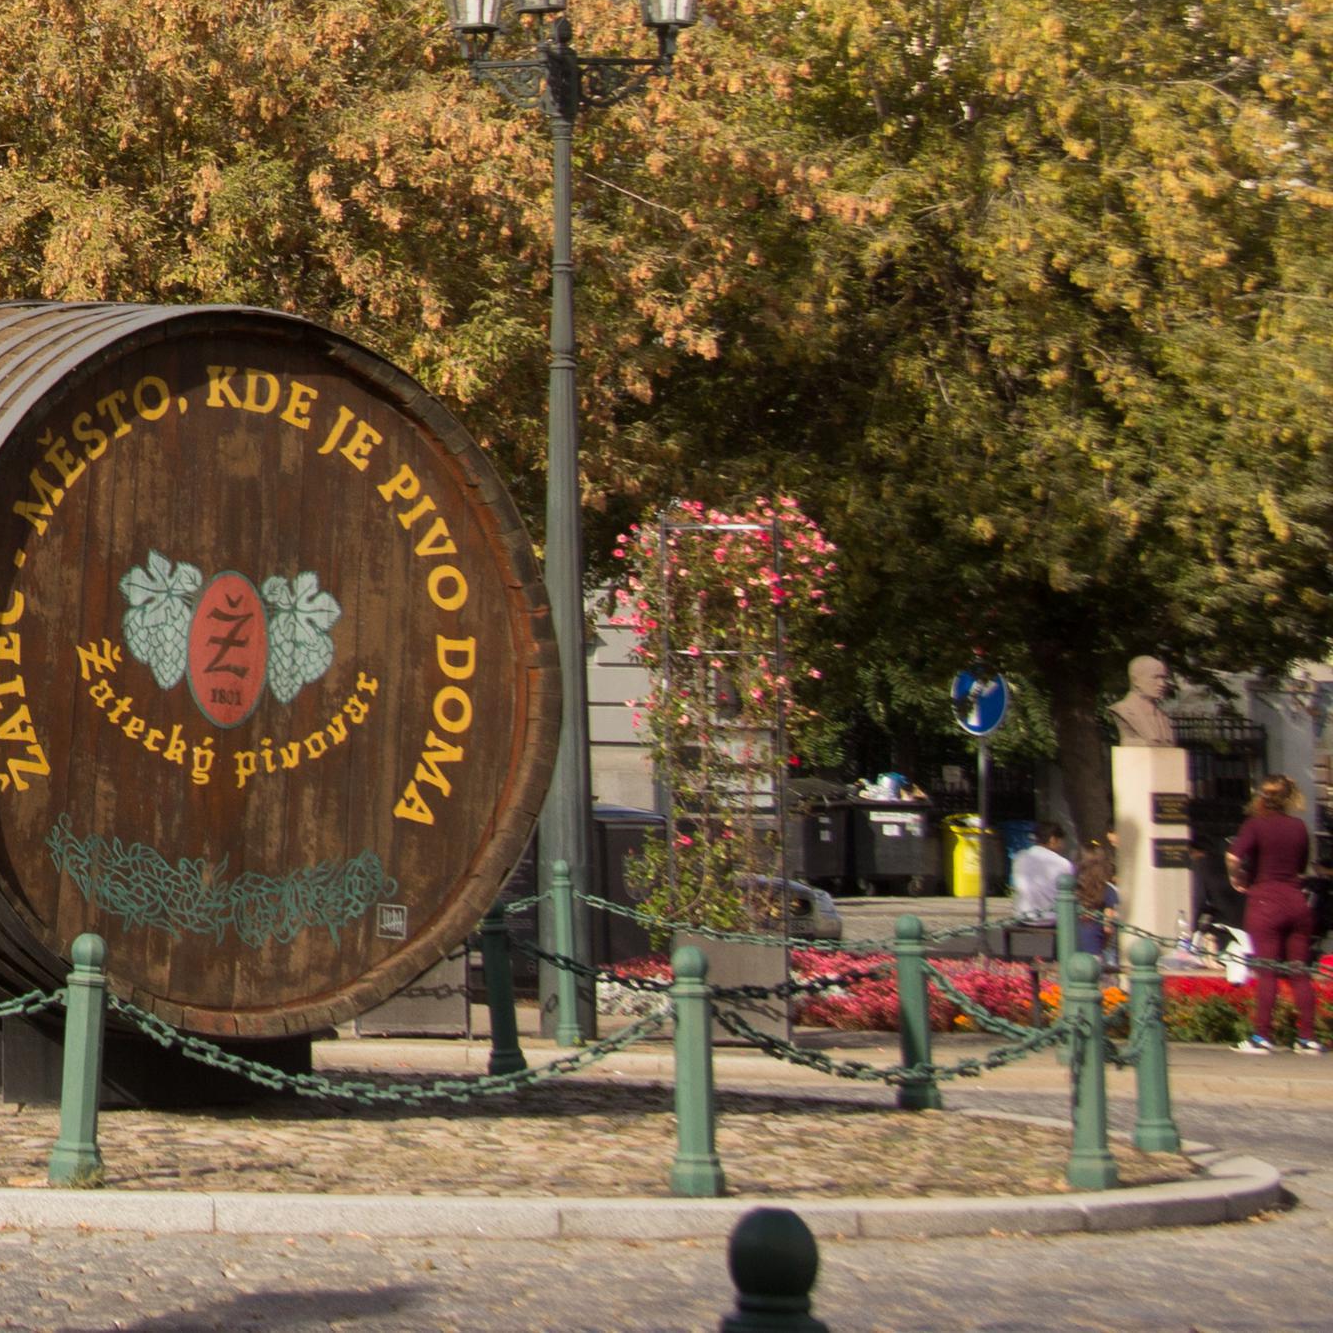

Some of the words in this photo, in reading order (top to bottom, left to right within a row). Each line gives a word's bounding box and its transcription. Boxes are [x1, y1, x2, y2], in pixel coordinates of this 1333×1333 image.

[13, 374, 189, 537] MĚSTO,
[206, 365, 319, 430] KDE
[317, 405, 383, 472] JE
[376, 464, 469, 612] PIVO
[75, 638, 215, 785] Žatecký
[234, 671, 379, 788] pivovar
[392, 634, 477, 825] DOMA
